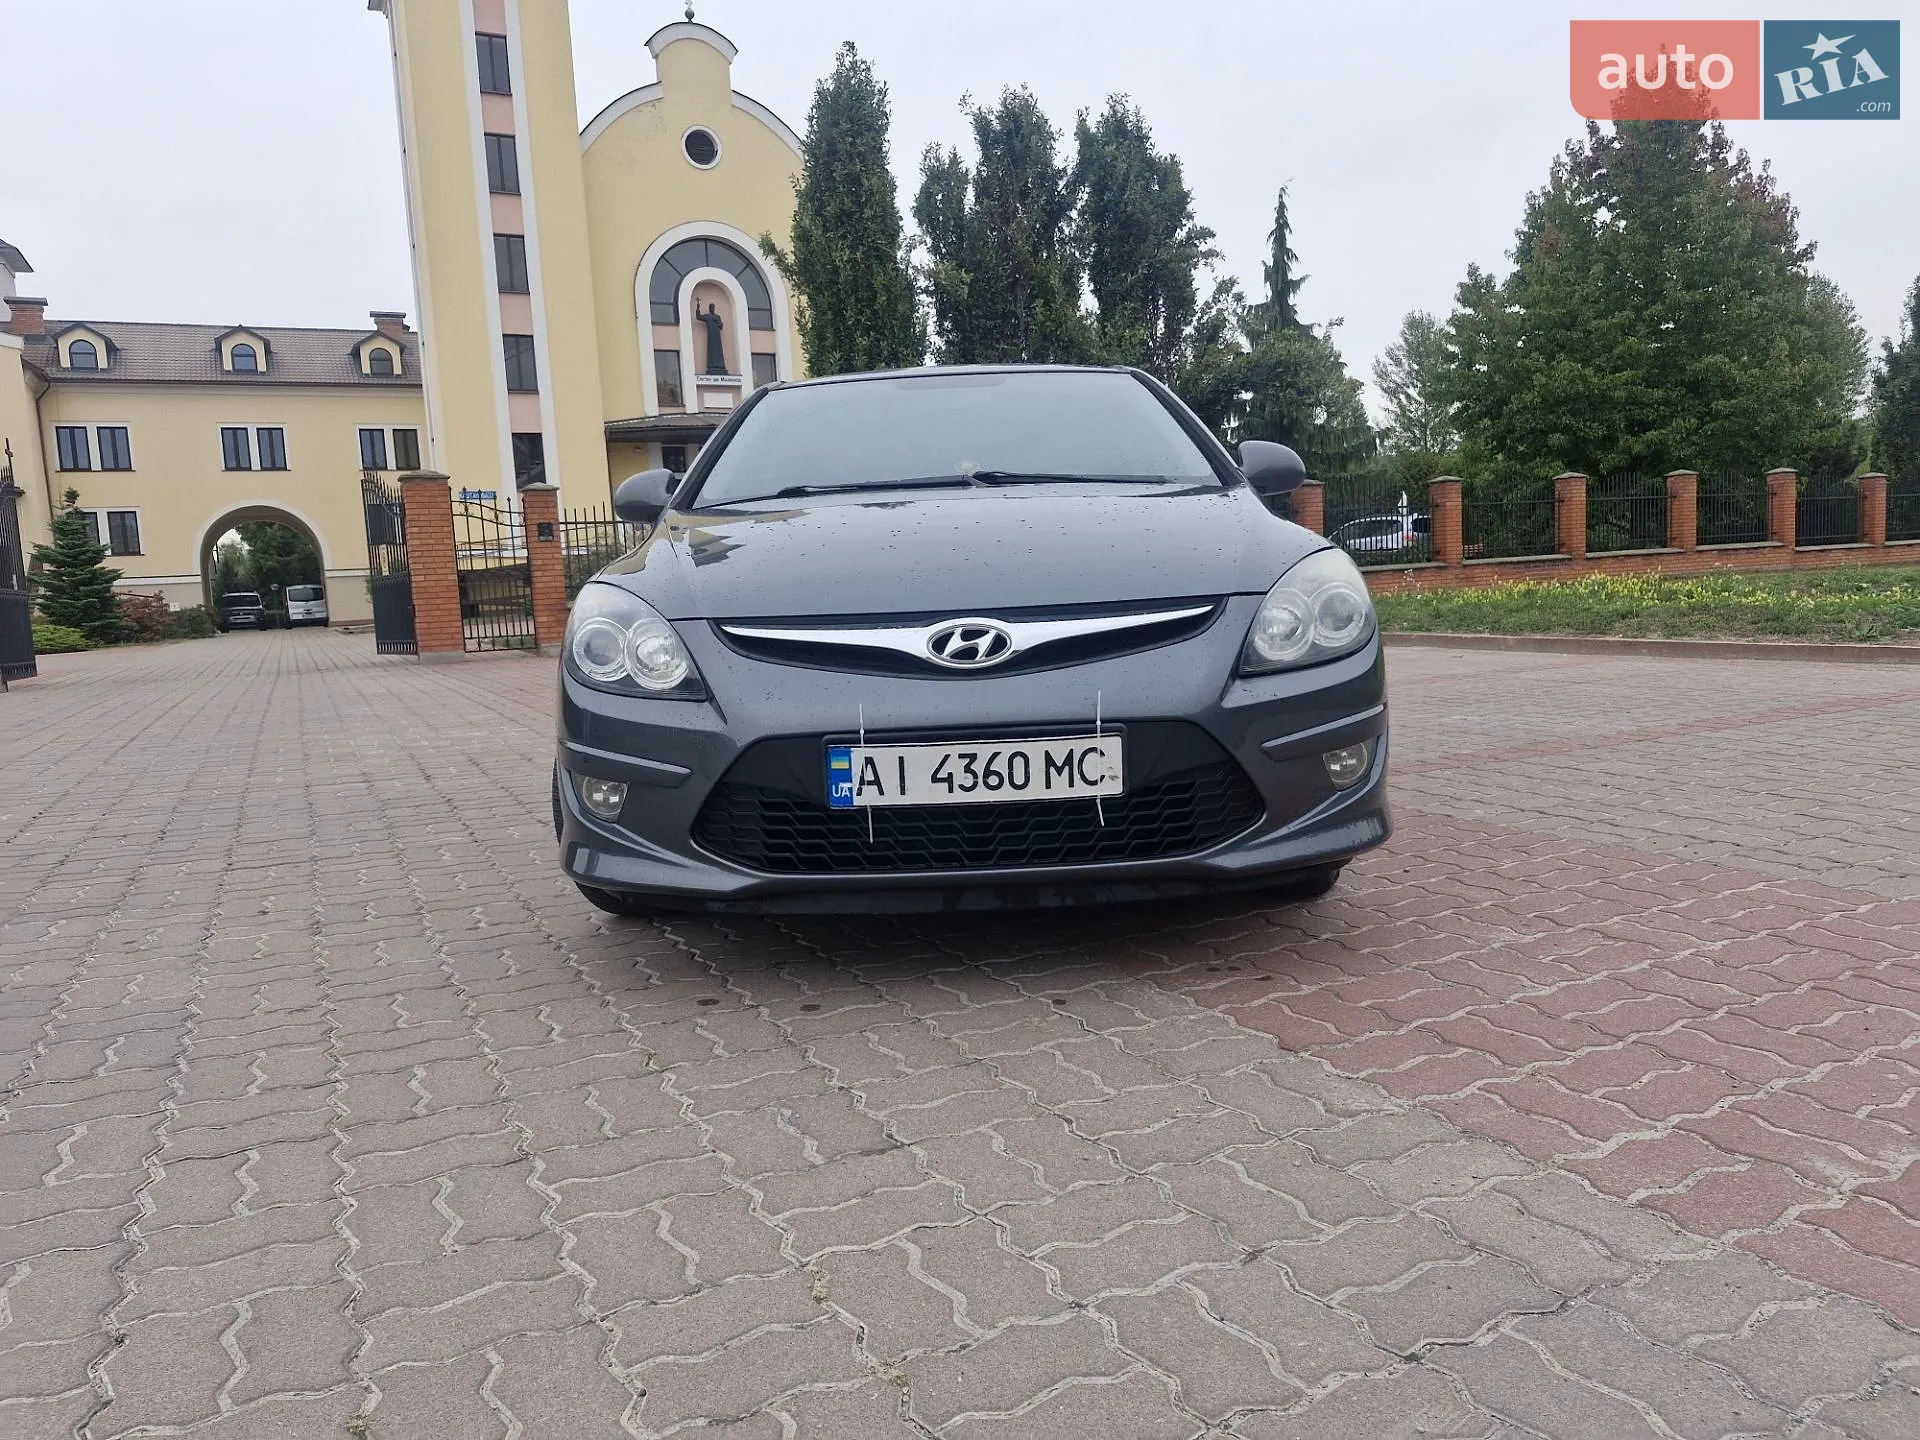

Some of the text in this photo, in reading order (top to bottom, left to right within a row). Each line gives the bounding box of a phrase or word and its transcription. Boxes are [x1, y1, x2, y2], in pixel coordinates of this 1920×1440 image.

[930, 750, 1031, 794] 4360
[1044, 746, 1106, 790] MC
[832, 784, 851, 798] UA
